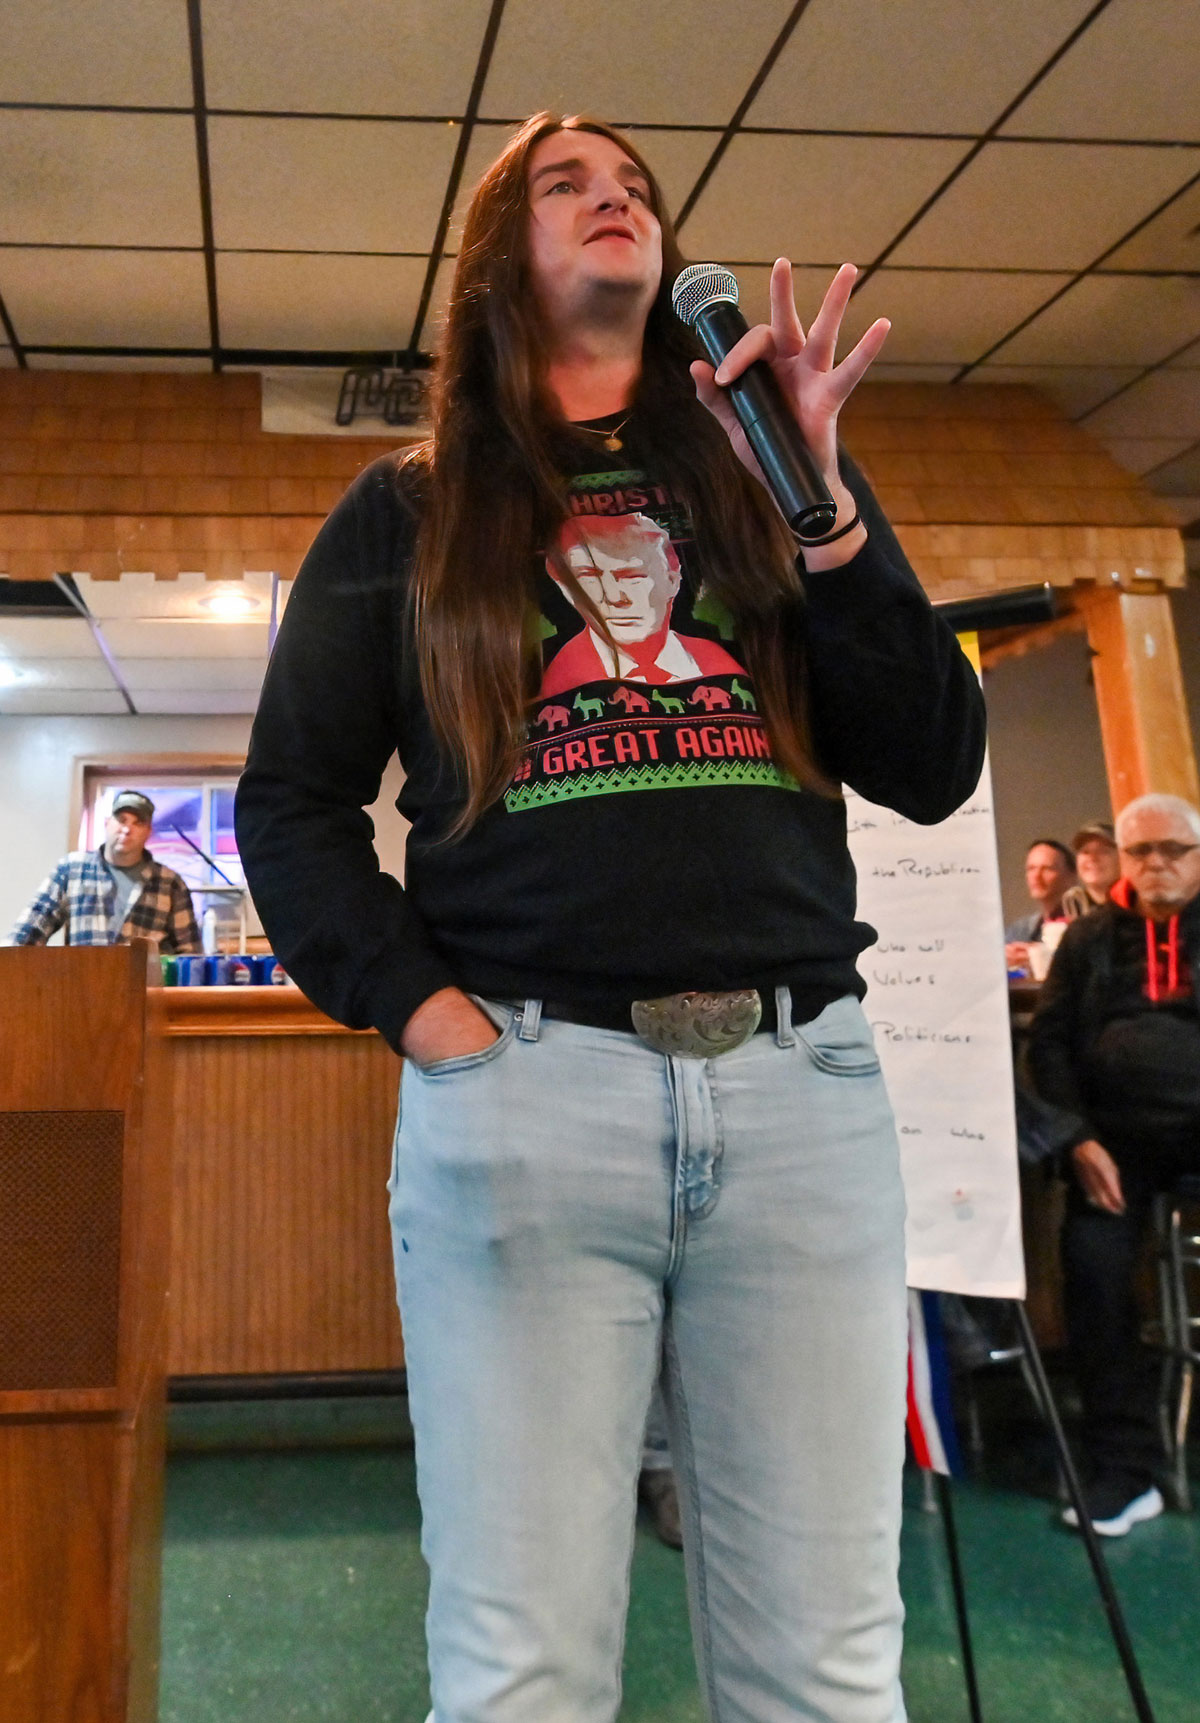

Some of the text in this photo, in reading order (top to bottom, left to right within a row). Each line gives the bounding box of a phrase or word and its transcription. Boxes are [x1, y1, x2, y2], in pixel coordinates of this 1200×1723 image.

[568, 486, 668, 515] HRIST
[542, 726, 772, 775] GREAT AGAIN
